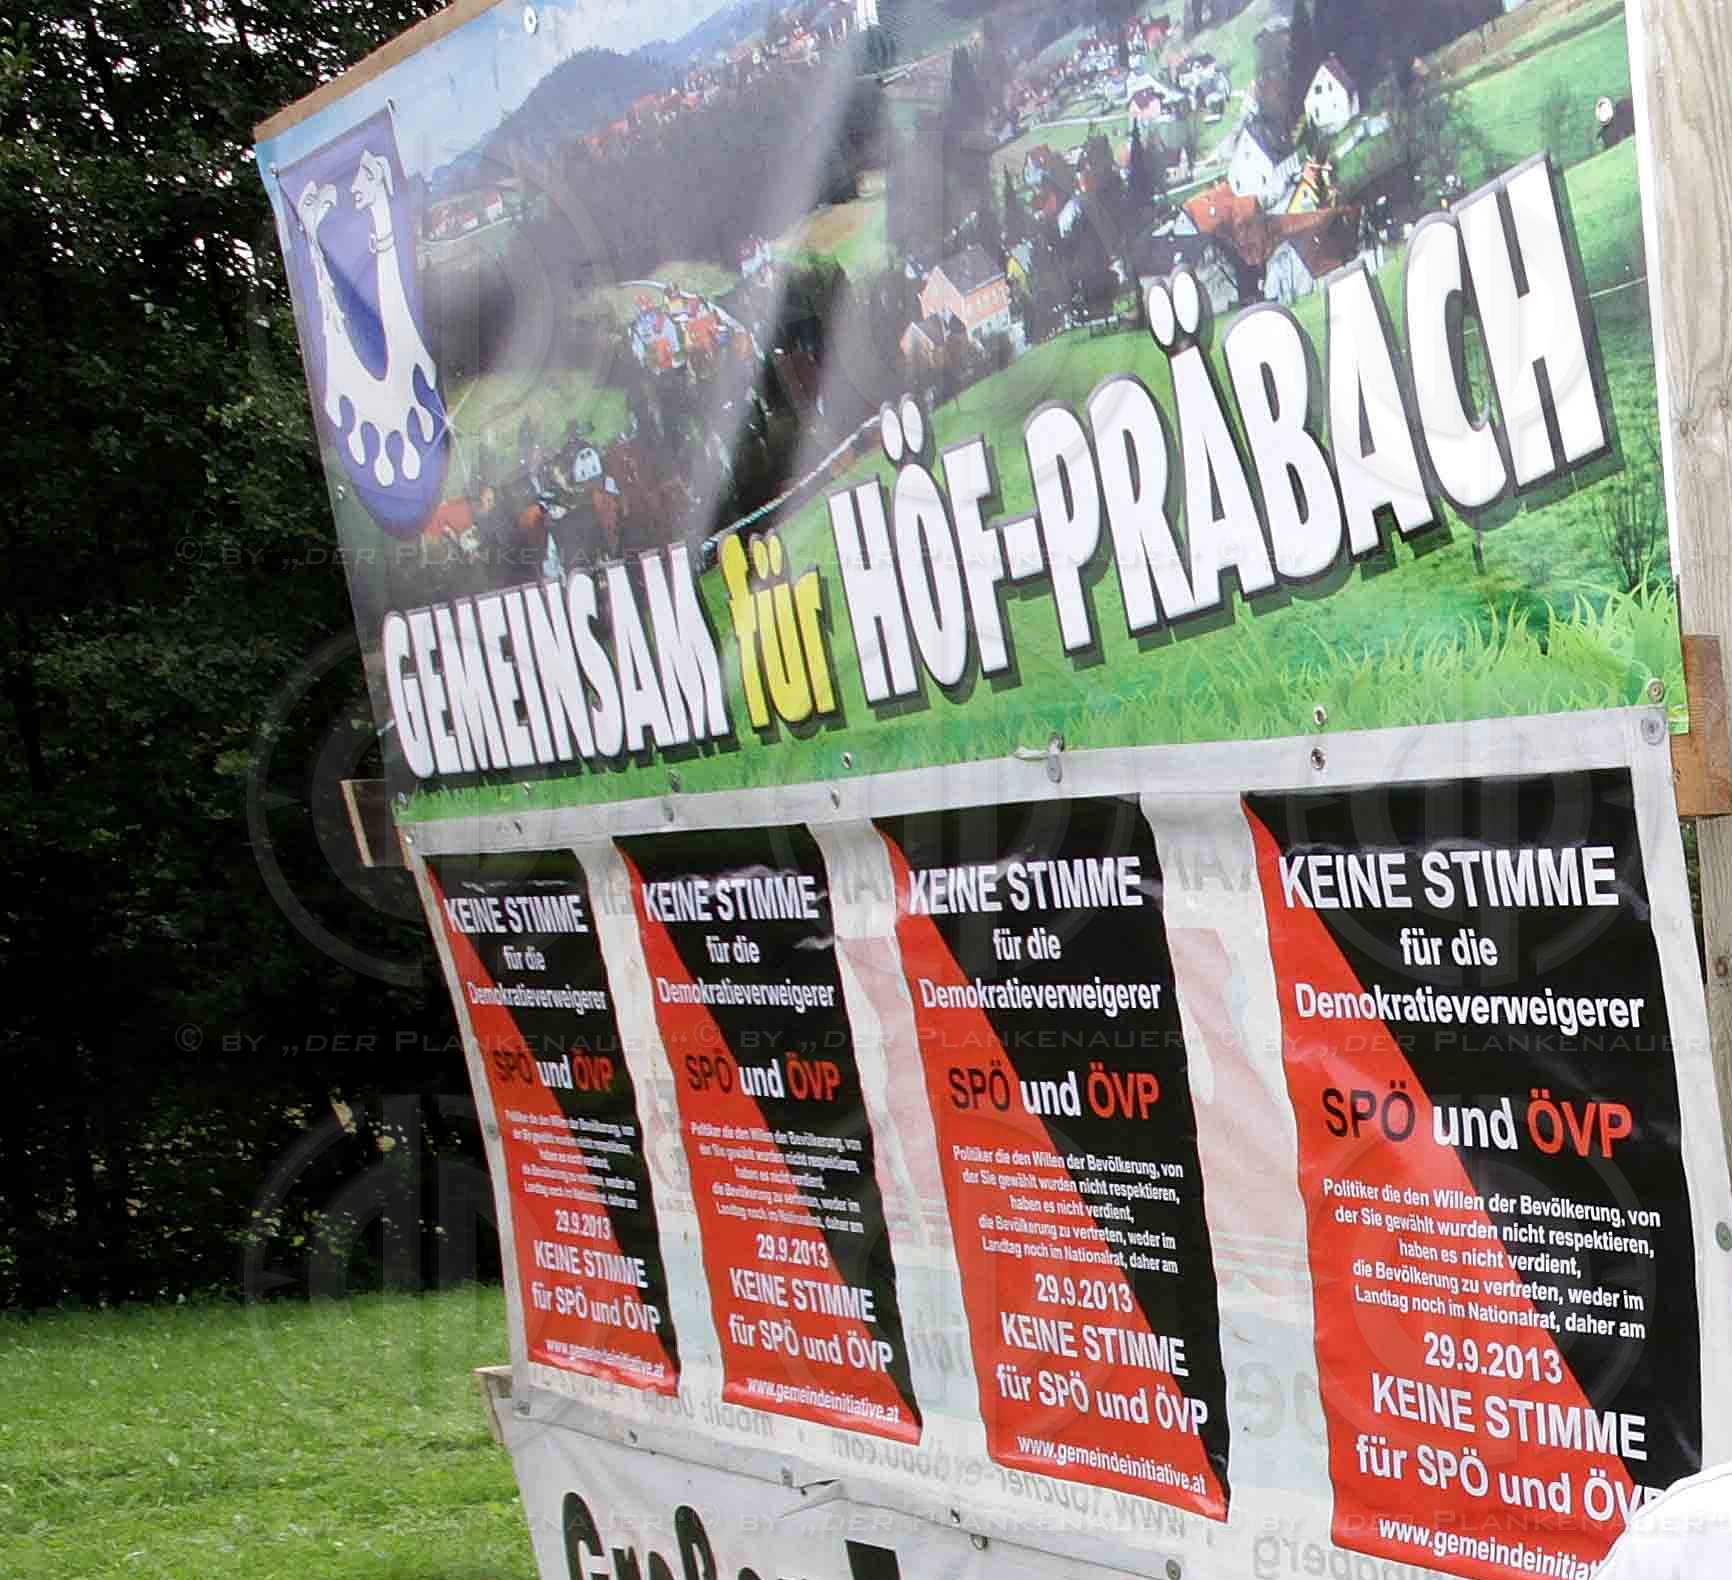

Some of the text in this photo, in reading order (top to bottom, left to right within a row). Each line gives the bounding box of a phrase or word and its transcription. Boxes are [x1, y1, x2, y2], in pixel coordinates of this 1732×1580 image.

[382, 152, 1608, 777] GEMEINSAM für HÖF-PRÄBACH
[642, 875, 821, 924] KEINE STIMME
[908, 855, 1143, 915] KEINE STIMME
[1278, 846, 1619, 910] KEINE STIMME
[443, 894, 589, 935] KEINE STIMME
[503, 945, 545, 971] für die
[706, 935, 760, 964] für die
[993, 928, 1062, 961] für die
[1400, 928, 1498, 966] für die
[658, 977, 836, 1014] Demokratieverweigerer
[920, 977, 1161, 1020] Demokratieverweigerer
[1295, 982, 1644, 1037] Demokratieverweigerer
[538, 1056, 573, 1089] und
[572, 1047, 615, 1092] ÖVP
[686, 1047, 842, 1102] SPÖ und ÖVP
[948, 1060, 1161, 1120] SPÖ und ÖVP
[1322, 1081, 1633, 1158] SPÖ und ÖVP
[1161, 1163, 1184, 1178] von
[1323, 1178, 1661, 1227] Politiker die den Willen der Bevölkerung, von
[756, 1233, 830, 1270] 29.9.2013
[1335, 1206, 1359, 1223] der
[1362, 1208, 1382, 1225] Sie
[1438, 1220, 1498, 1241] wurden
[1502, 1222, 1544, 1244] nicht
[1549, 1229, 1655, 1258] respektieren,
[534, 1240, 649, 1289] KEINE STIMME
[1399, 1238, 1582, 1279] haben es nicht verdient,
[531, 1281, 662, 1335] für SPÖ und ÖVP
[729, 1266, 878, 1324] KEINE STIMME
[1034, 1272, 1136, 1314] 29.9.2013
[1353, 1259, 1645, 1311] die Bevölkerung zu vertreten, weder im
[1355, 1285, 1646, 1340] Landtag noch im Nationalrat, daher am
[728, 1313, 894, 1374] für SPÖ und ÖVP
[1000, 1311, 1190, 1377] KEINE STIMME
[1423, 1332, 1563, 1384] 29.9.2013
[995, 1363, 1209, 1436] für SPÖ und ÖVP
[1372, 1372, 1648, 1461] KEINE STIMME
[1017, 1434, 1208, 1496] www.gemeindeinitiative.at
[1356, 1434, 1407, 1480] für
[1416, 1444, 1488, 1497] SPÖ
[1499, 1473, 1571, 1514] und
